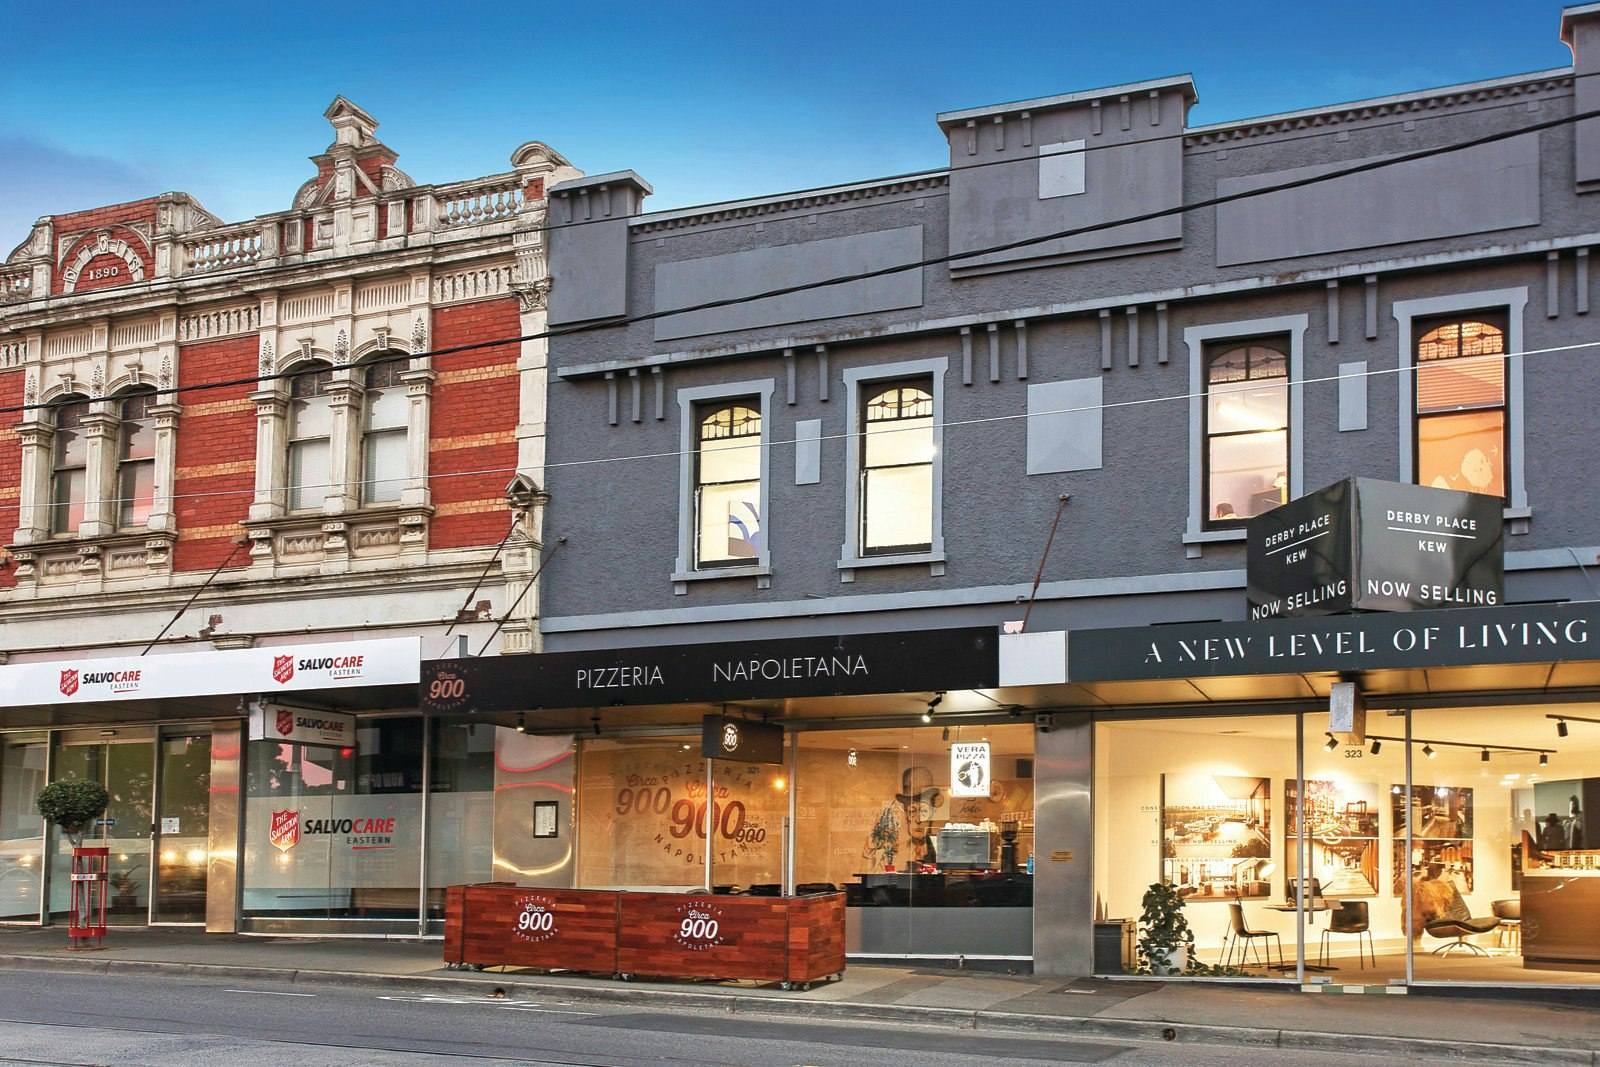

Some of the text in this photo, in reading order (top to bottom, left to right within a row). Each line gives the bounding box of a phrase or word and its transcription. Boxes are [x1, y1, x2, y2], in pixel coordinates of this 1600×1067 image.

[89, 266, 119, 281] 1890
[1386, 509, 1477, 531] DERBY PLACE
[1265, 514, 1330, 548] DERBY PLACE
[1418, 540, 1447, 553] KEW
[1286, 548, 1307, 565] KEW
[1252, 580, 1346, 621] NOW SELLING
[1367, 579, 1497, 606] NOW SELLING
[1144, 619, 1588, 663] A NEW LEVEL OF LIVING
[298, 656, 364, 671] SALVOCARE
[83, 670, 141, 684] SALVOCARE
[329, 668, 361, 677] EASTERN
[577, 655, 868, 689] PIZZERIA NAPOLETANA
[110, 682, 139, 690] EASTERN
[430, 679, 465, 699] 900
[296, 717, 344, 732] SALVOCARE
[1344, 749, 1363, 758] 323
[746, 766, 760, 775] 321
[626, 773, 659, 787] Circa
[686, 779, 729, 799] Cica
[615, 786, 672, 816] 900
[276, 812, 288, 826] THE
[304, 818, 396, 834] SALVOCARE
[669, 799, 746, 839] 900
[280, 826, 297, 847] ARMY
[346, 836, 391, 845] EASTERN
[735, 828, 766, 843] 900
[518, 911, 553, 931] 900
[688, 909, 710, 919] Circa
[680, 918, 718, 939] 900
